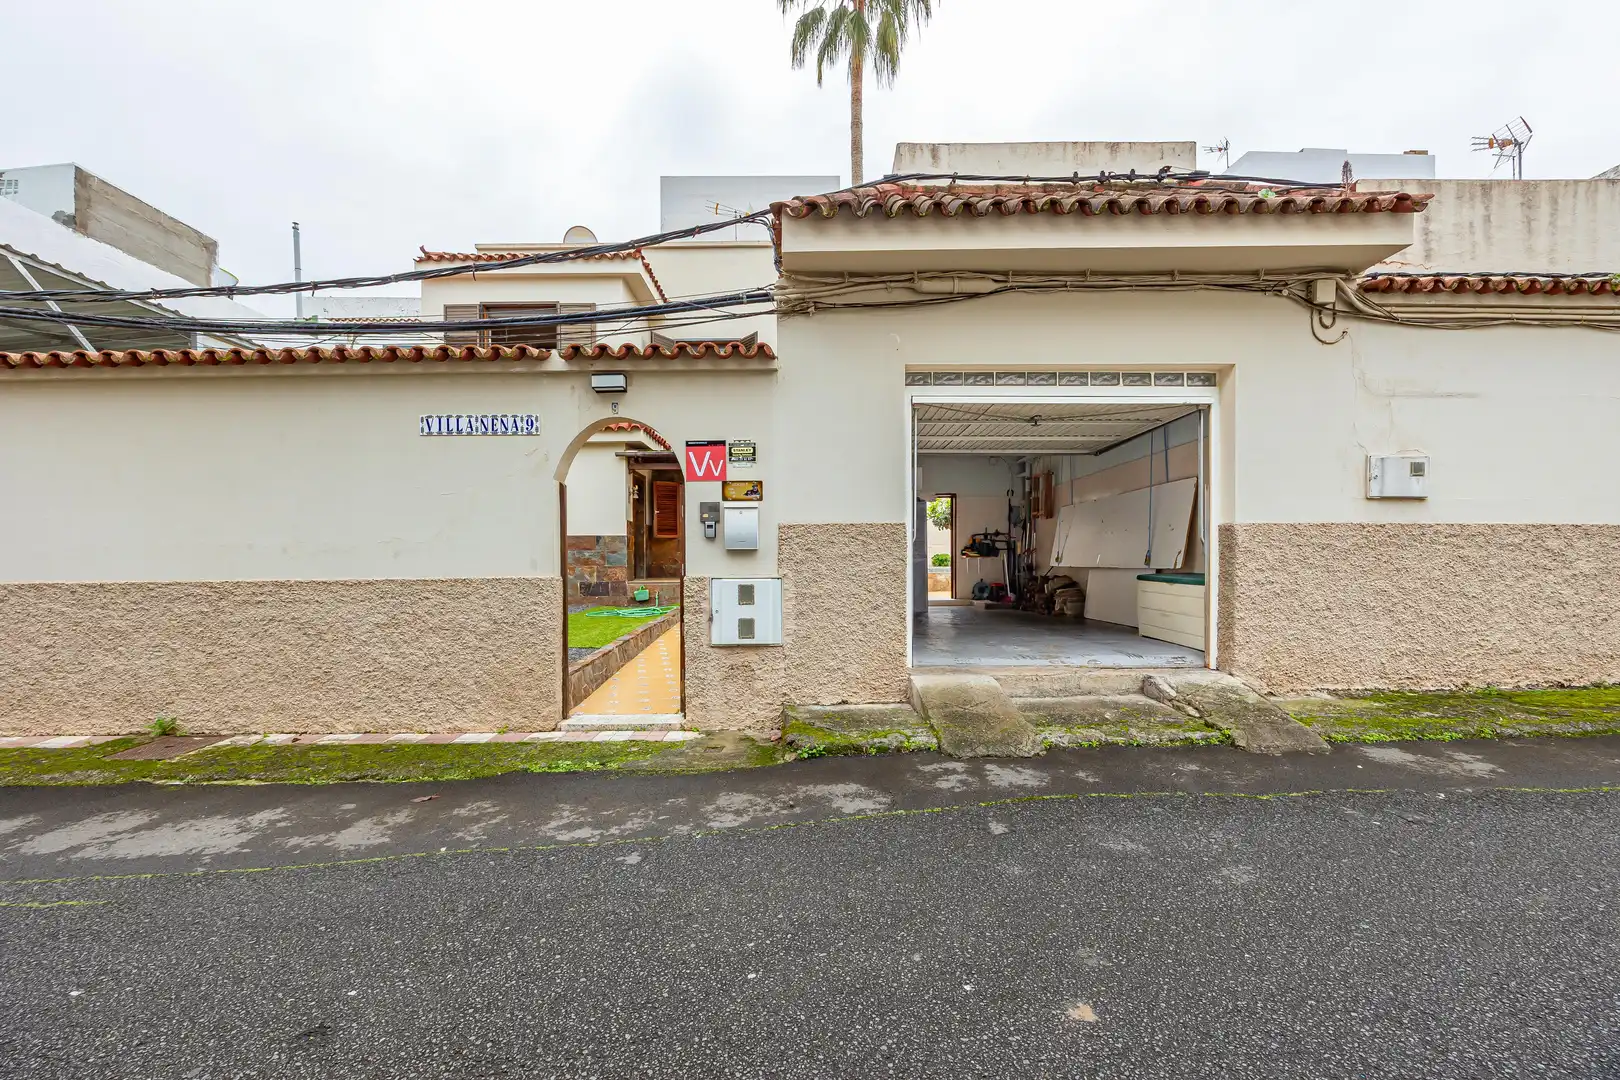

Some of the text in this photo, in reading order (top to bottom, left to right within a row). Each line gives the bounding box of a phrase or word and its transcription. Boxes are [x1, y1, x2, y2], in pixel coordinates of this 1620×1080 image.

[611, 402, 619, 414] 9
[425, 418, 534, 432] VILLA NENA 9
